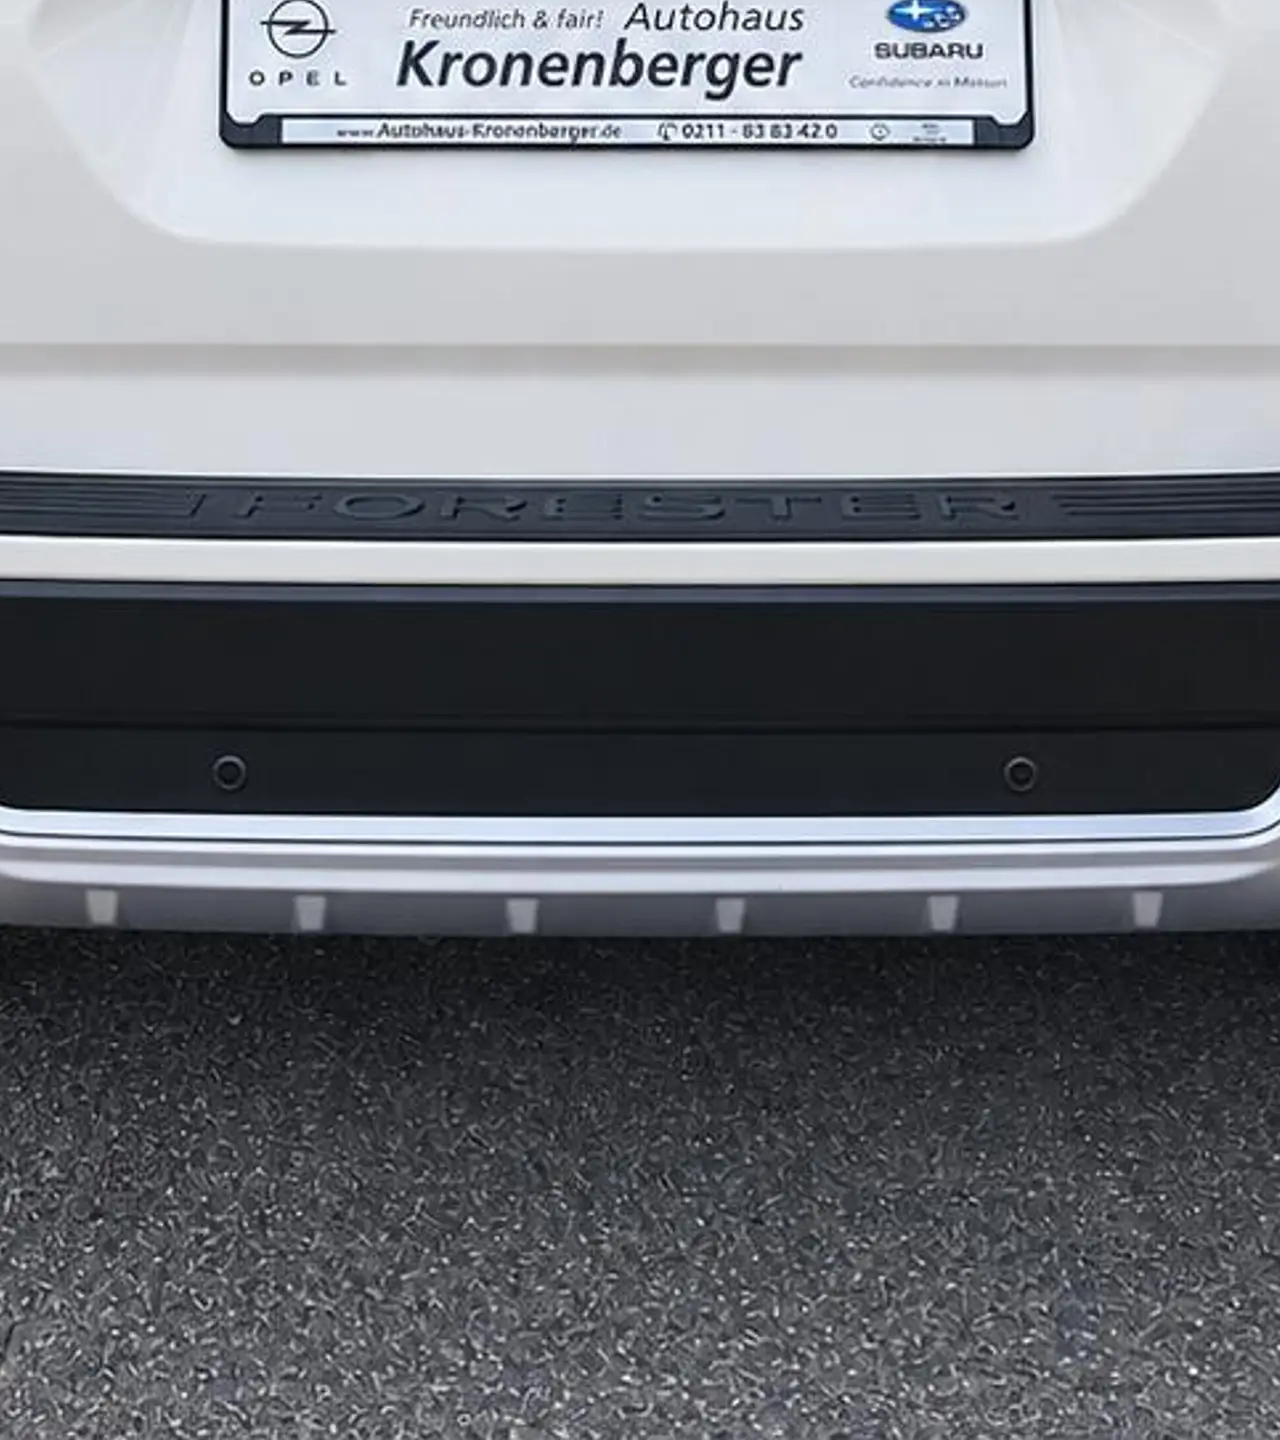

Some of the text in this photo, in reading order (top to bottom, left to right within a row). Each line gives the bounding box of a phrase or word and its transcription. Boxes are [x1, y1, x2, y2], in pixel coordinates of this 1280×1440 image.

[408, 0, 805, 32] Freundlich & fair! Autohaus
[874, 42, 984, 60] SUBARU
[249, 69, 348, 87] OPEL
[396, 38, 803, 101] Kronenberger
[234, 493, 1020, 522] FORESTER
